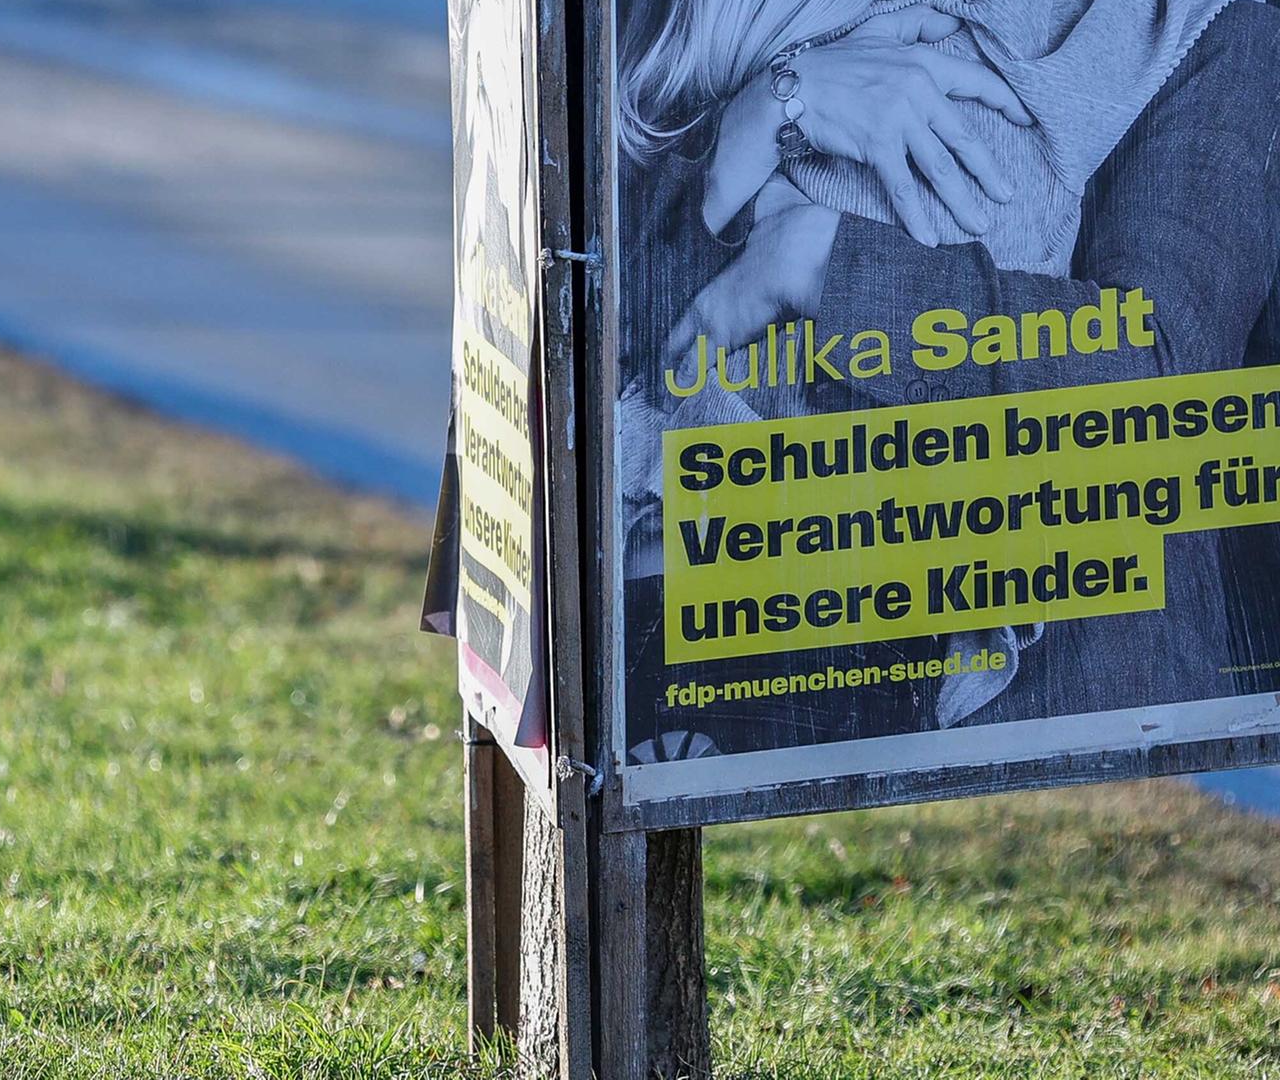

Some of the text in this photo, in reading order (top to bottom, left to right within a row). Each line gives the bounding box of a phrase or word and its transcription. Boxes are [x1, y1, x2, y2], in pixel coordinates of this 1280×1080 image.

[464, 339, 513, 424] Schulden
[665, 286, 1155, 398] Julika Sandt
[678, 415, 990, 493] Schulden
[464, 494, 530, 592] unsere Kinder
[678, 472, 1181, 567] Verantwortung
[680, 549, 1148, 642] unsere Kinder.
